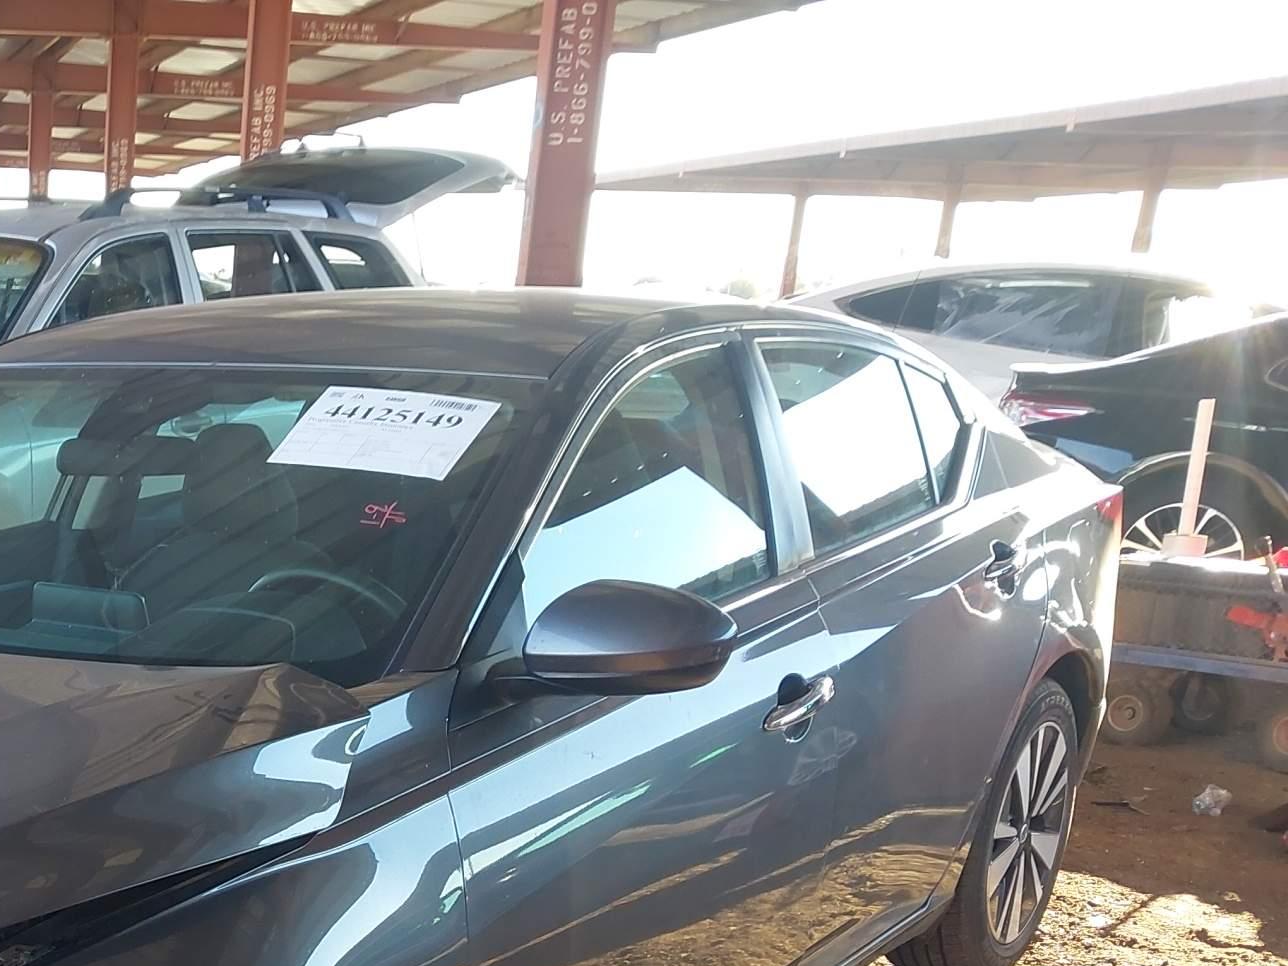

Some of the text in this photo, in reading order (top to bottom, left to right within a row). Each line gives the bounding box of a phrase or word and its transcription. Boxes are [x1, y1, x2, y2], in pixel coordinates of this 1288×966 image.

[553, 7, 578, 93] PREFAB
[567, 1, 599, 143] 1-866-799-0
[325, 404, 464, 429] 44125149
